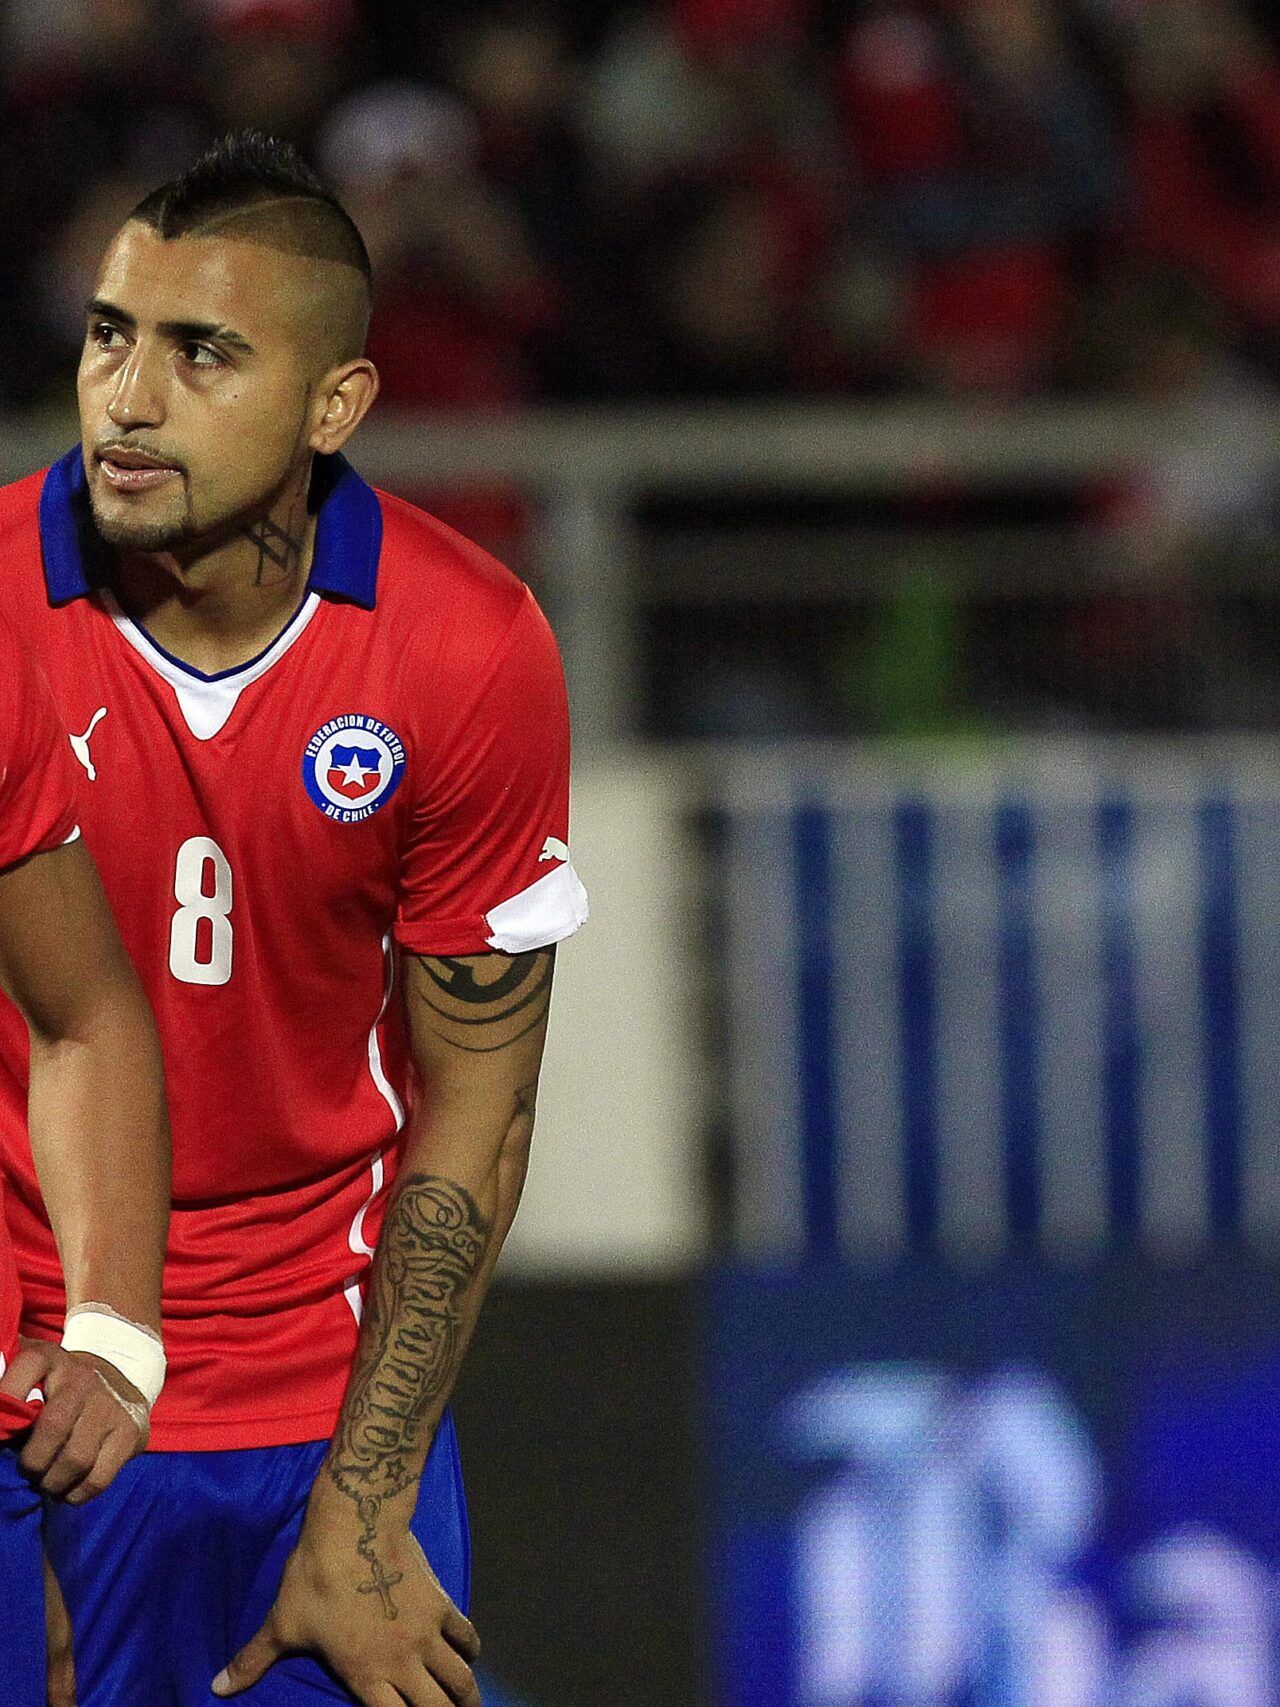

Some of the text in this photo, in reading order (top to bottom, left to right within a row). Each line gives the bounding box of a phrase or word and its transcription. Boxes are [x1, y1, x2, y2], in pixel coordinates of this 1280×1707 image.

[305, 715, 405, 766] FEDERACION DE FUTBOL
[325, 805, 375, 822] DE CHILE
[169, 836, 233, 985] 8
